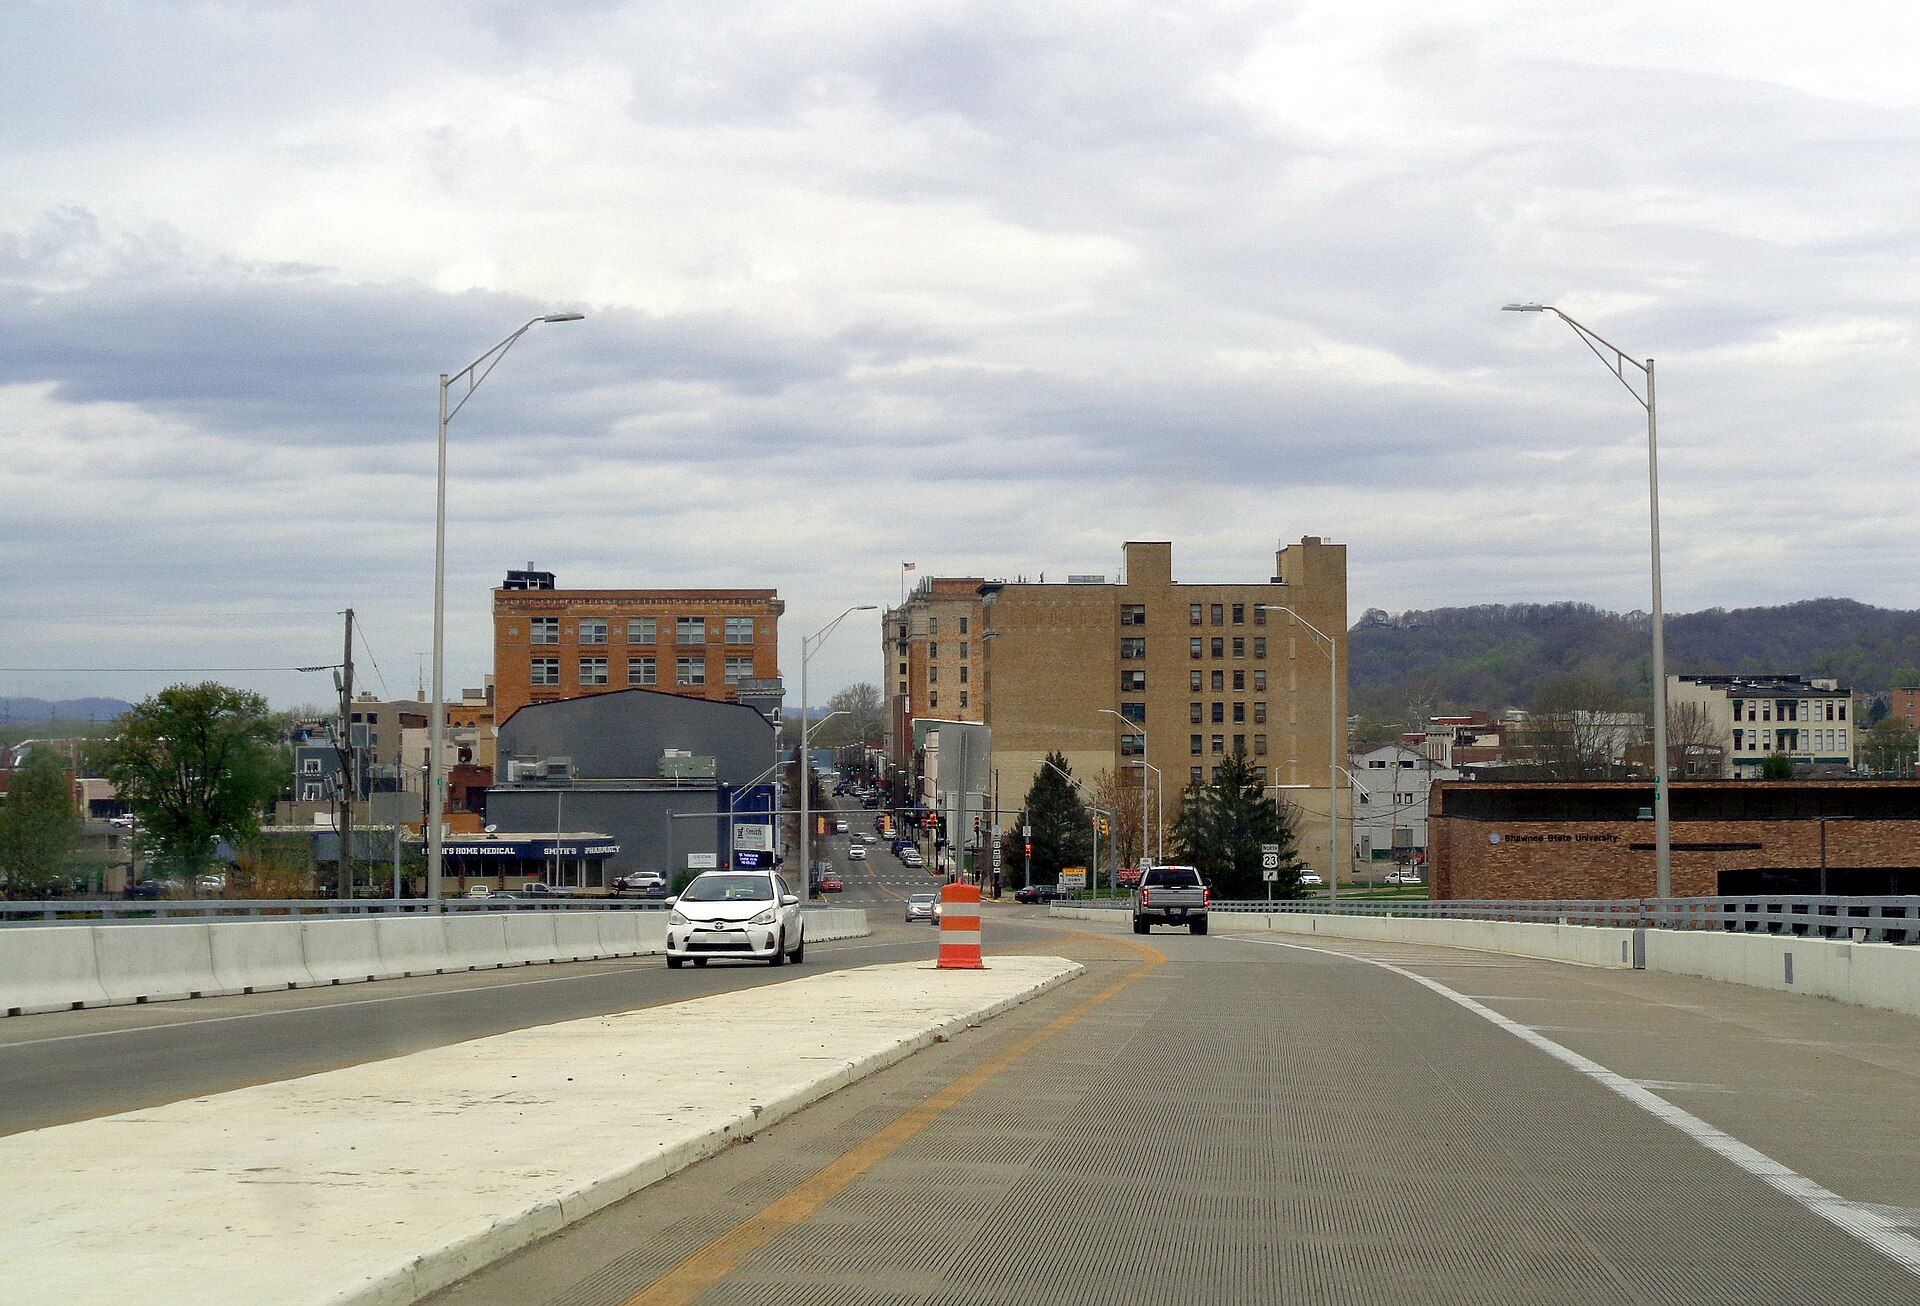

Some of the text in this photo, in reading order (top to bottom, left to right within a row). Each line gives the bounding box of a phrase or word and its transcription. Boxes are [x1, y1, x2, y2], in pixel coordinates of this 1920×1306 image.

[1504, 833, 1618, 843] Shawnee State University
[455, 847, 479, 855] HOME
[479, 847, 516, 855] MEDICAL
[543, 845, 621, 855] SMITH'S PHARMACY
[1265, 856, 1276, 866] 23
